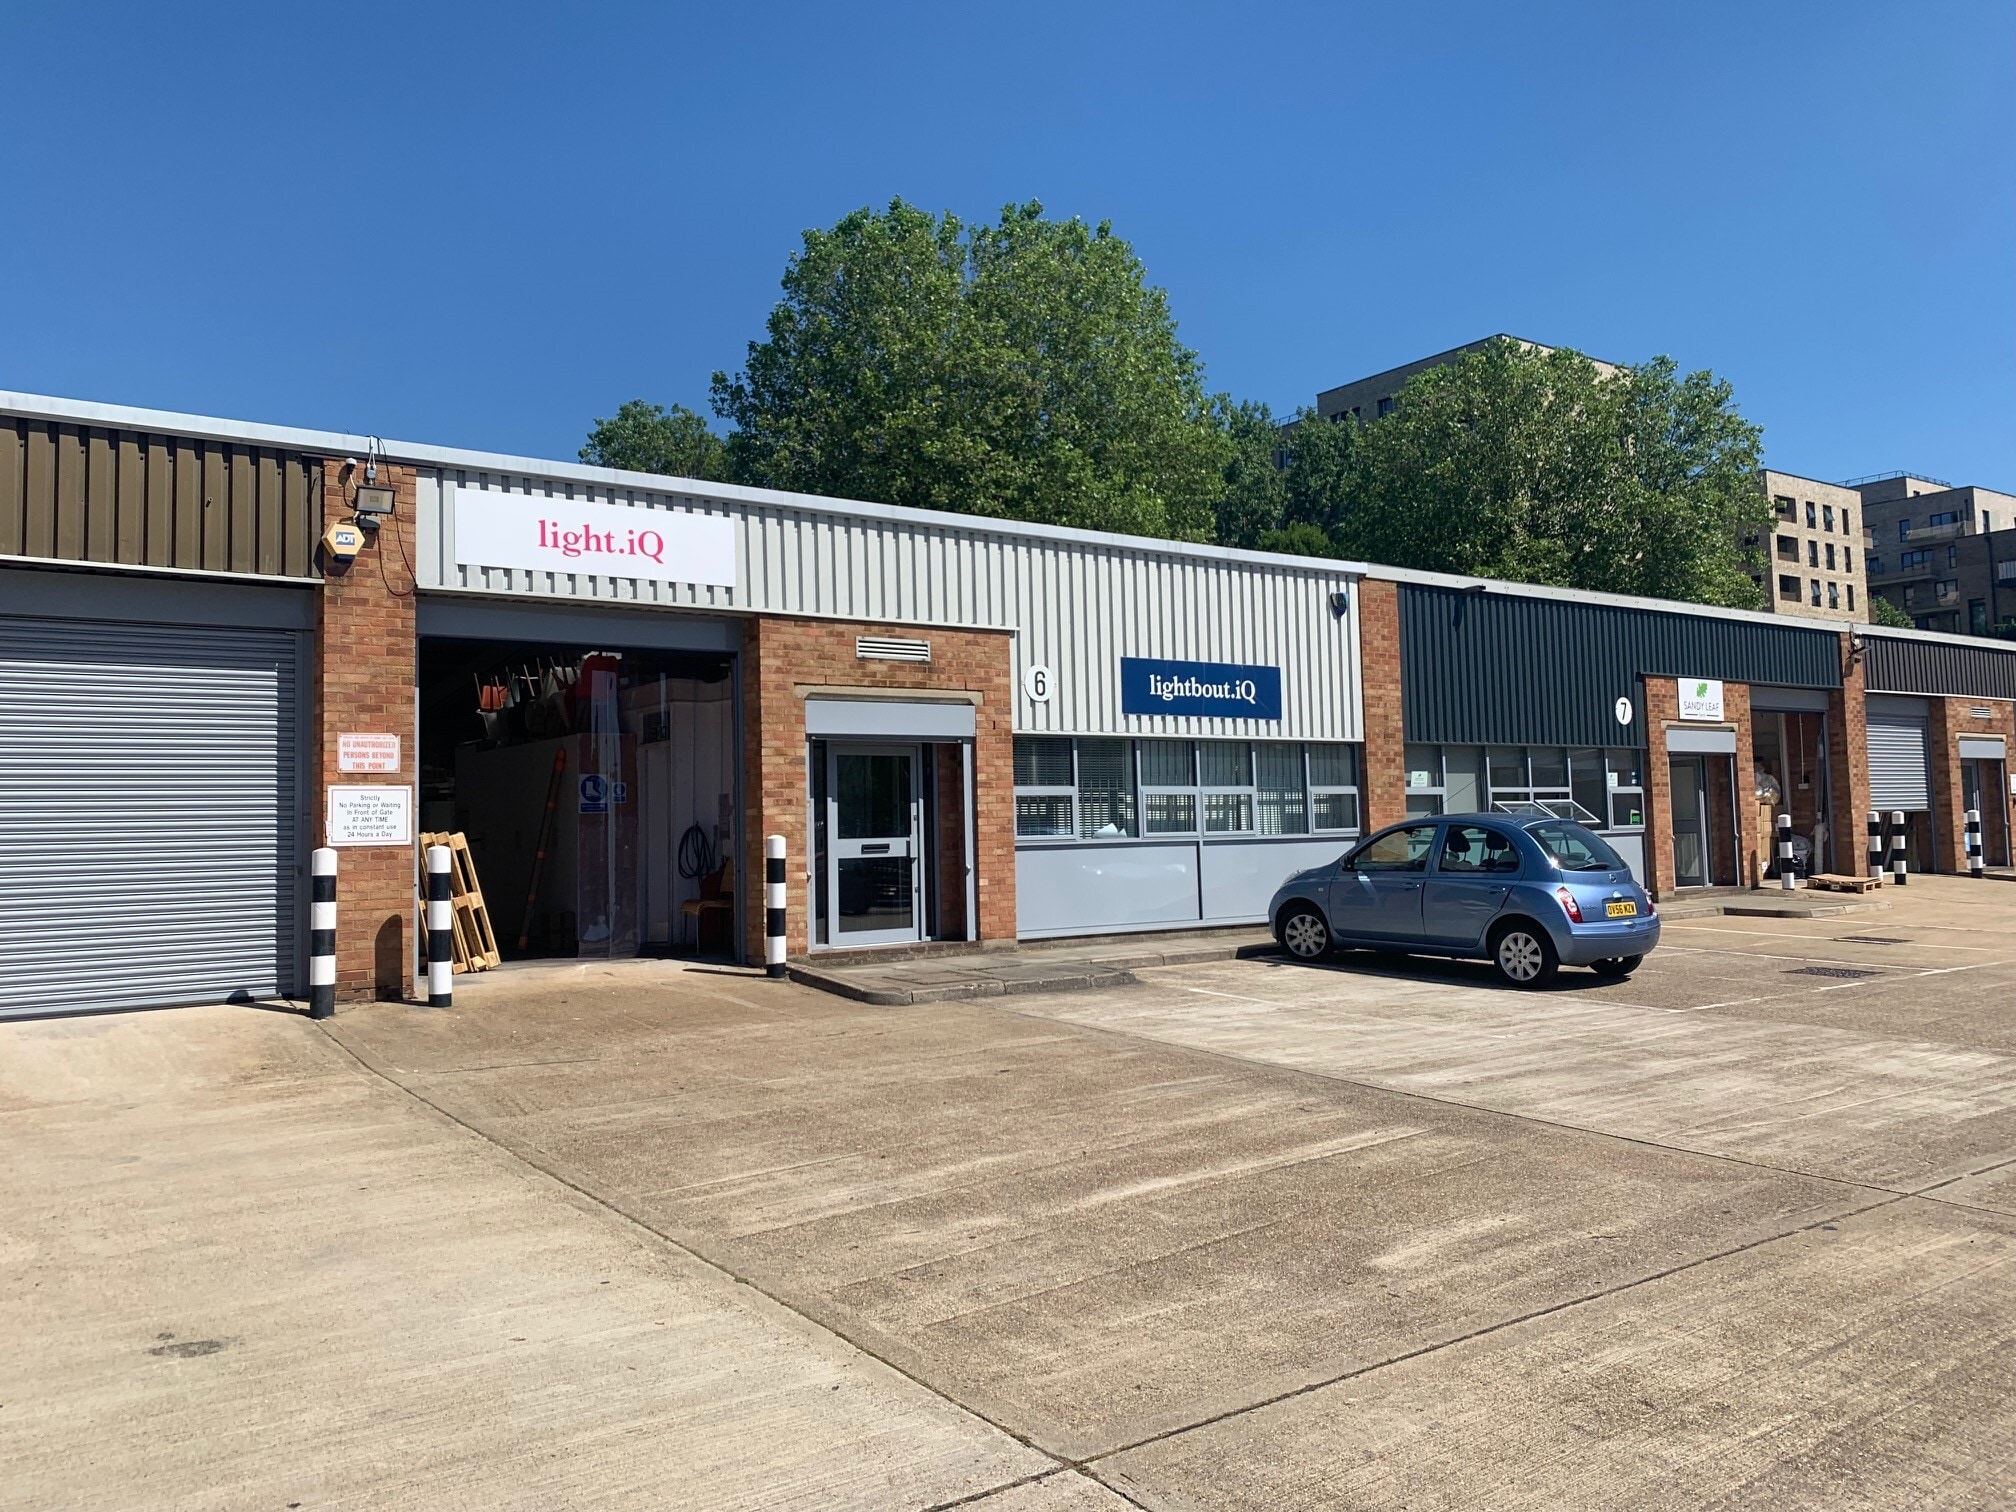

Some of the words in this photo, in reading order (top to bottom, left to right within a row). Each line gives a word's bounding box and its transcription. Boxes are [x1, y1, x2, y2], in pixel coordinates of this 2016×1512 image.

[336, 533, 355, 544] ADT
[537, 519, 664, 564] light.iQ
[1034, 671, 1046, 696] 6
[1149, 674, 1256, 704] lightbout.iQ
[1620, 701, 1627, 720] 7
[1683, 701, 1705, 711] SANDY
[1705, 702, 1720, 712] LEAF
[342, 740, 351, 748] NO
[352, 741, 396, 749] UNAUTHORIZED
[343, 751, 370, 759] PERSONS
[371, 751, 395, 759] BEYOND
[352, 761, 366, 770] THIS
[368, 762, 386, 770] POINT
[360, 794, 381, 802] Strictly
